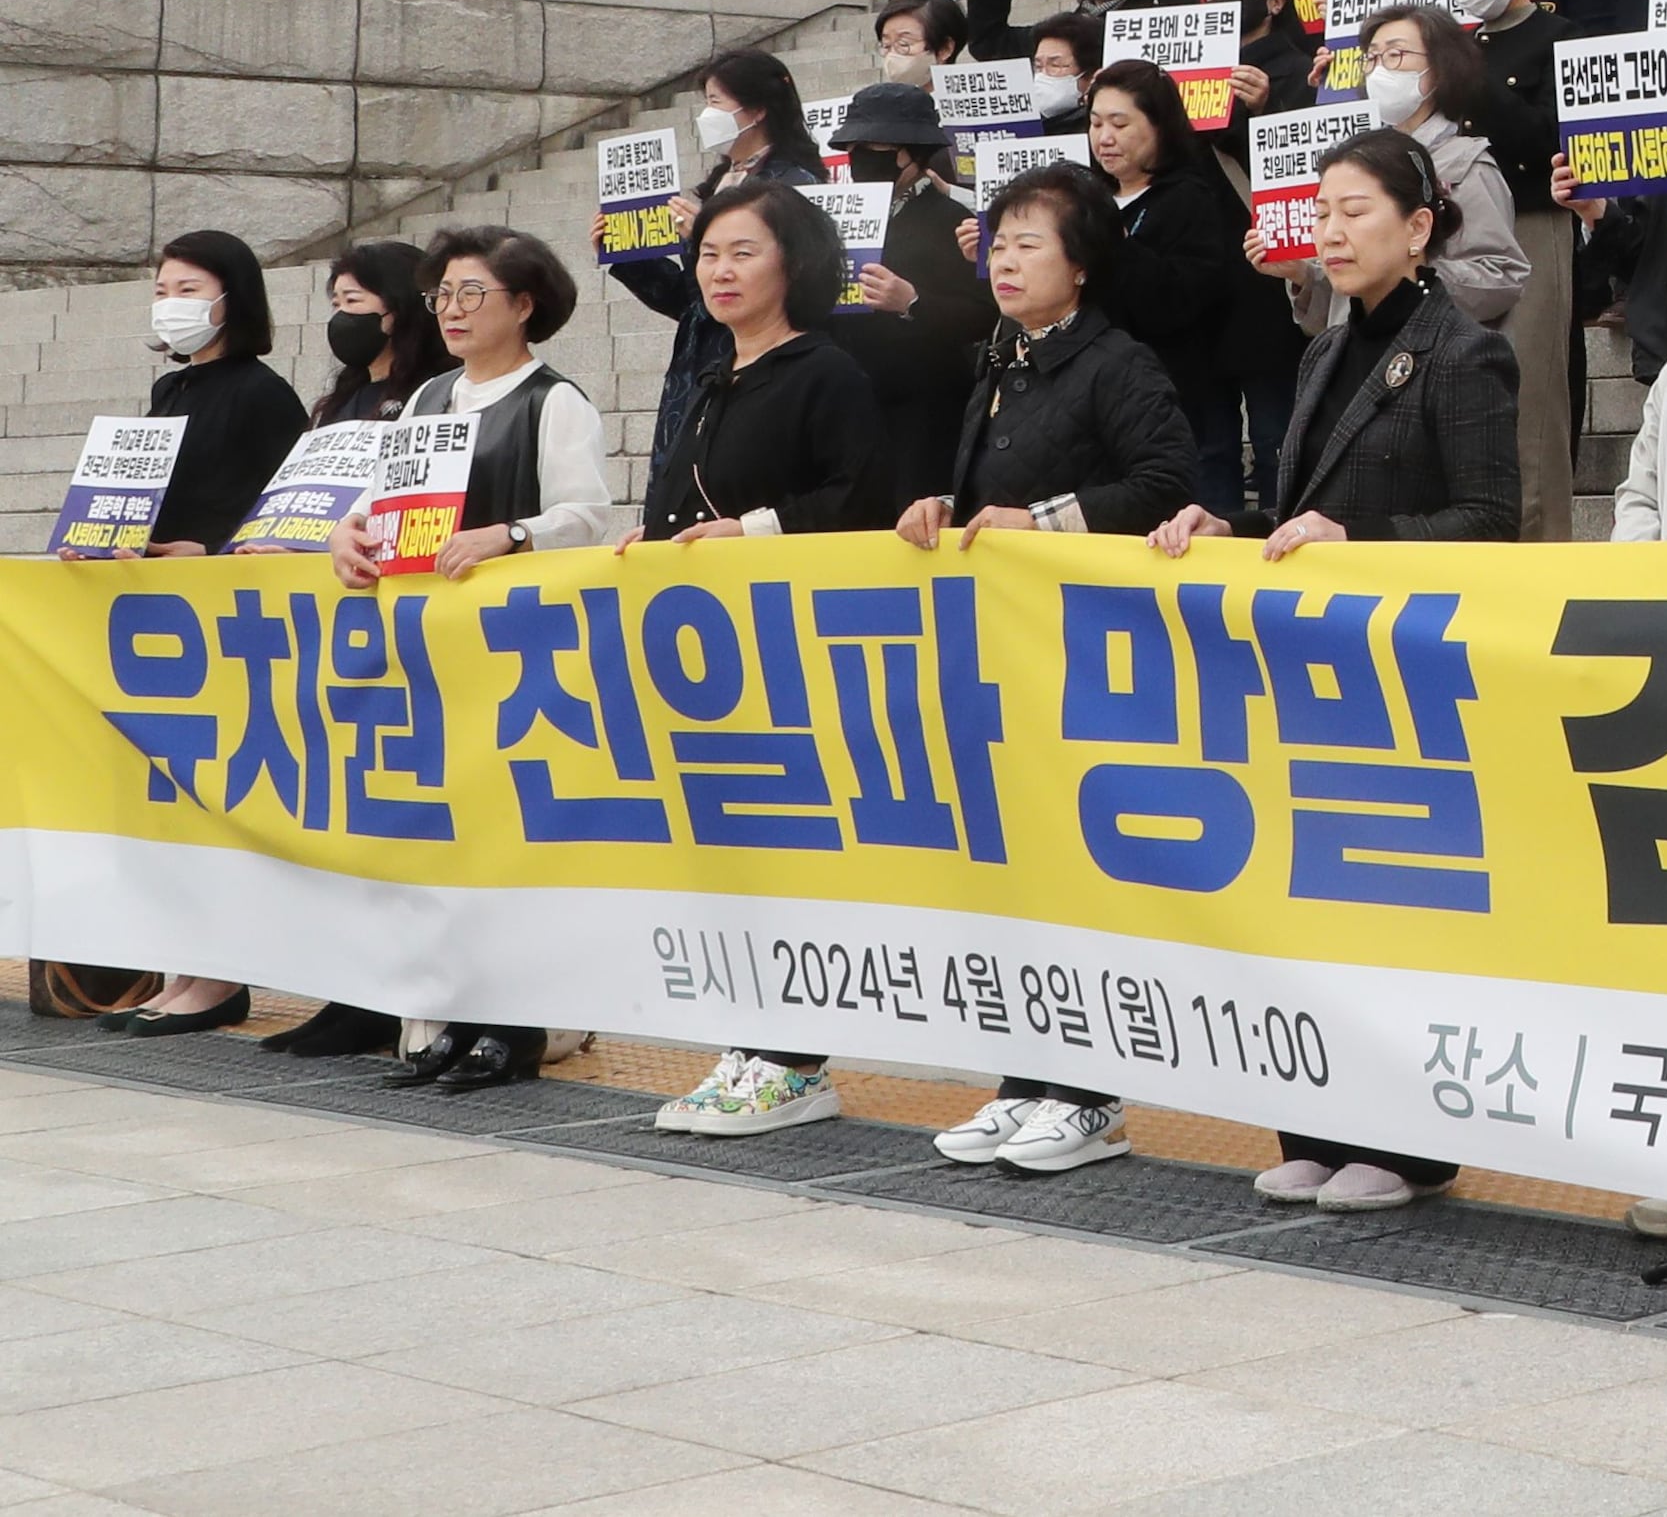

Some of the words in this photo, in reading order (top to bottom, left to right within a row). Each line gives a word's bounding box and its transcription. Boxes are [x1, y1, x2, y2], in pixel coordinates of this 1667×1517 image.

[1112, 18, 1140, 42] 후보
[1147, 15, 1179, 39] 맘에
[1183, 12, 1199, 37] 안
[1203, 9, 1235, 35] 들면
[1560, 54, 1621, 105] 당선되면
[1261, 150, 1307, 180] 친일파로
[414, 424, 430, 453] 안
[434, 423, 468, 452] 들면
[102, 589, 456, 842] 유치원
[481, 577, 1005, 864] 친일파
[1059, 584, 1490, 913] 망발
[652, 926, 736, 1003] 일시
[773, 939, 927, 1022] 2024년
[943, 952, 1010, 1035] 4월
[1020, 964, 1092, 1048] 8일
[1101, 968, 1180, 1068] (월)
[1192, 995, 1328, 1087] 11:00
[1424, 1023, 1539, 1126] 장소
